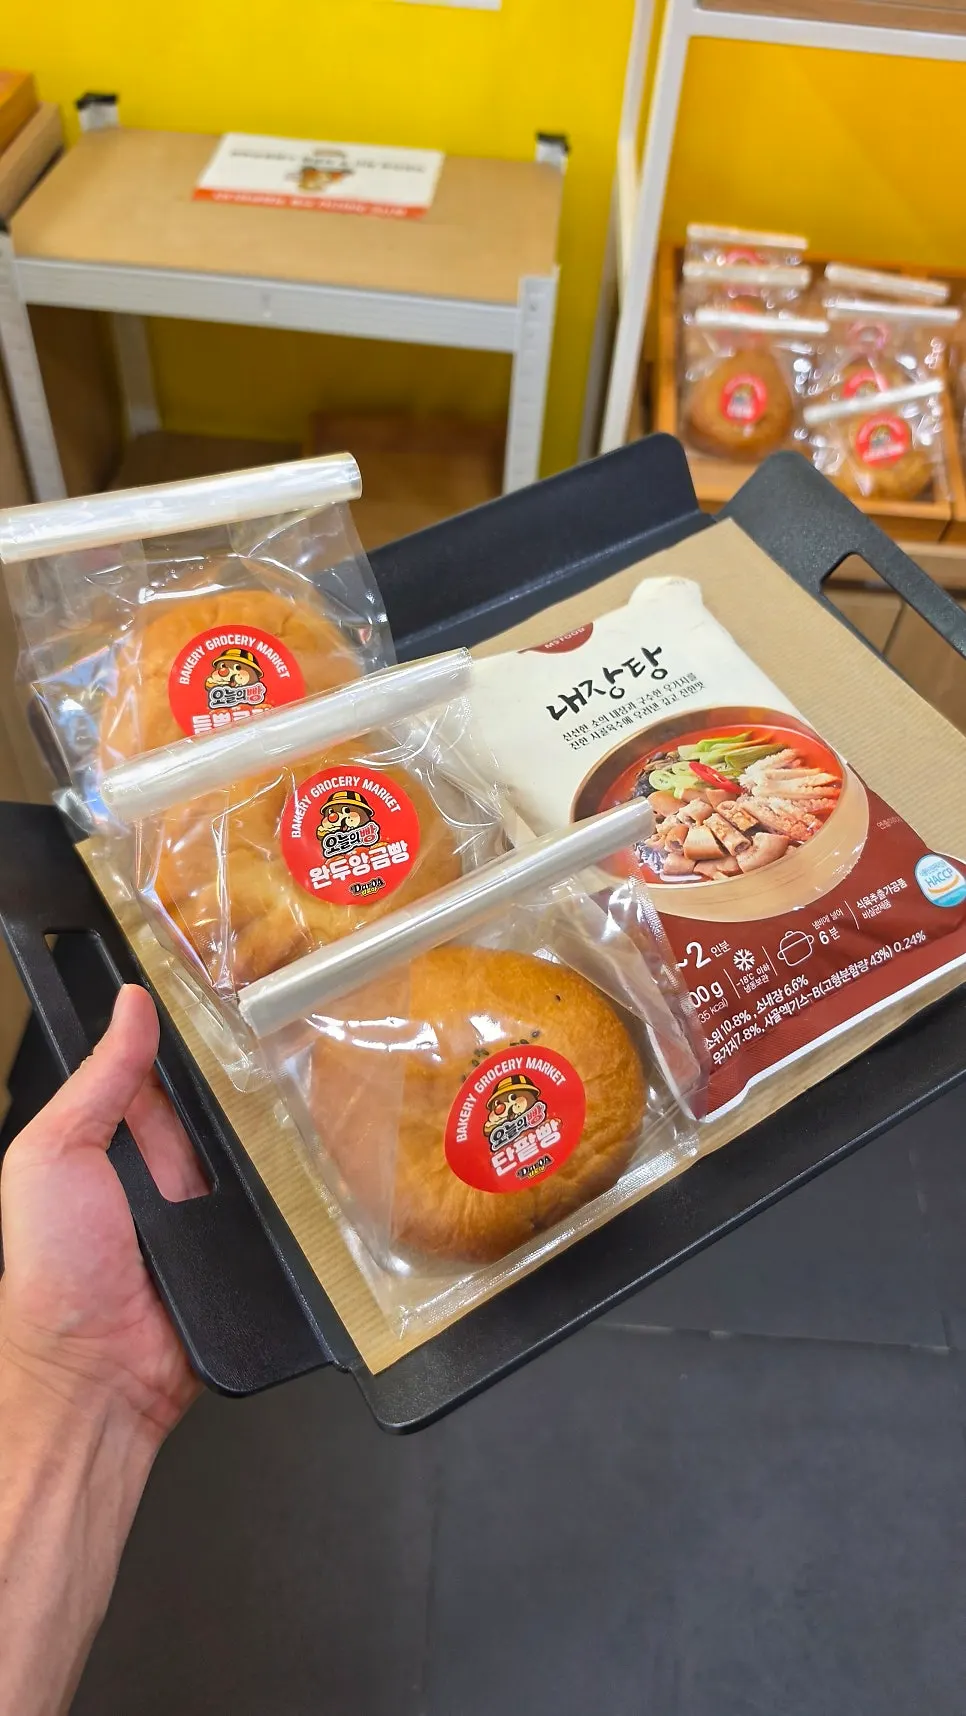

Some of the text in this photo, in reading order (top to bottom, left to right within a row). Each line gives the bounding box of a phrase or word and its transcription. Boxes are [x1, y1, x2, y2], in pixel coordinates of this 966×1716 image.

[179, 634, 291, 685] BAKERY GROCERY MARKET
[211, 685, 264, 706] 오늘의빵
[546, 646, 668, 721] 내장탕
[562, 672, 697, 742] 신선한 소의 내장과 구수한 우거지를
[291, 776, 401, 838] BAKERY GROCERY MARKET
[324, 823, 379, 855] 오늘의빵
[309, 840, 410, 890] 완두앙금빵
[925, 868, 953, 887] HACCP
[856, 878, 908, 909] 식육추출가공품
[711, 940, 731, 957] 인분
[818, 926, 840, 945] 6 분
[870, 945, 893, 966] 43%)
[894, 930, 926, 953] 0.24%
[743, 974, 769, 993] 냉동보관
[756, 963, 770, 975] 이하
[688, 981, 724, 1008] 00 g
[756, 988, 784, 1014] 소내장
[784, 974, 808, 996] 6.6%
[456, 1057, 567, 1143] BAKERY GROCERY MARKET
[492, 1104, 544, 1148] 오늘의빵
[491, 1119, 561, 1176] 단팥빵
